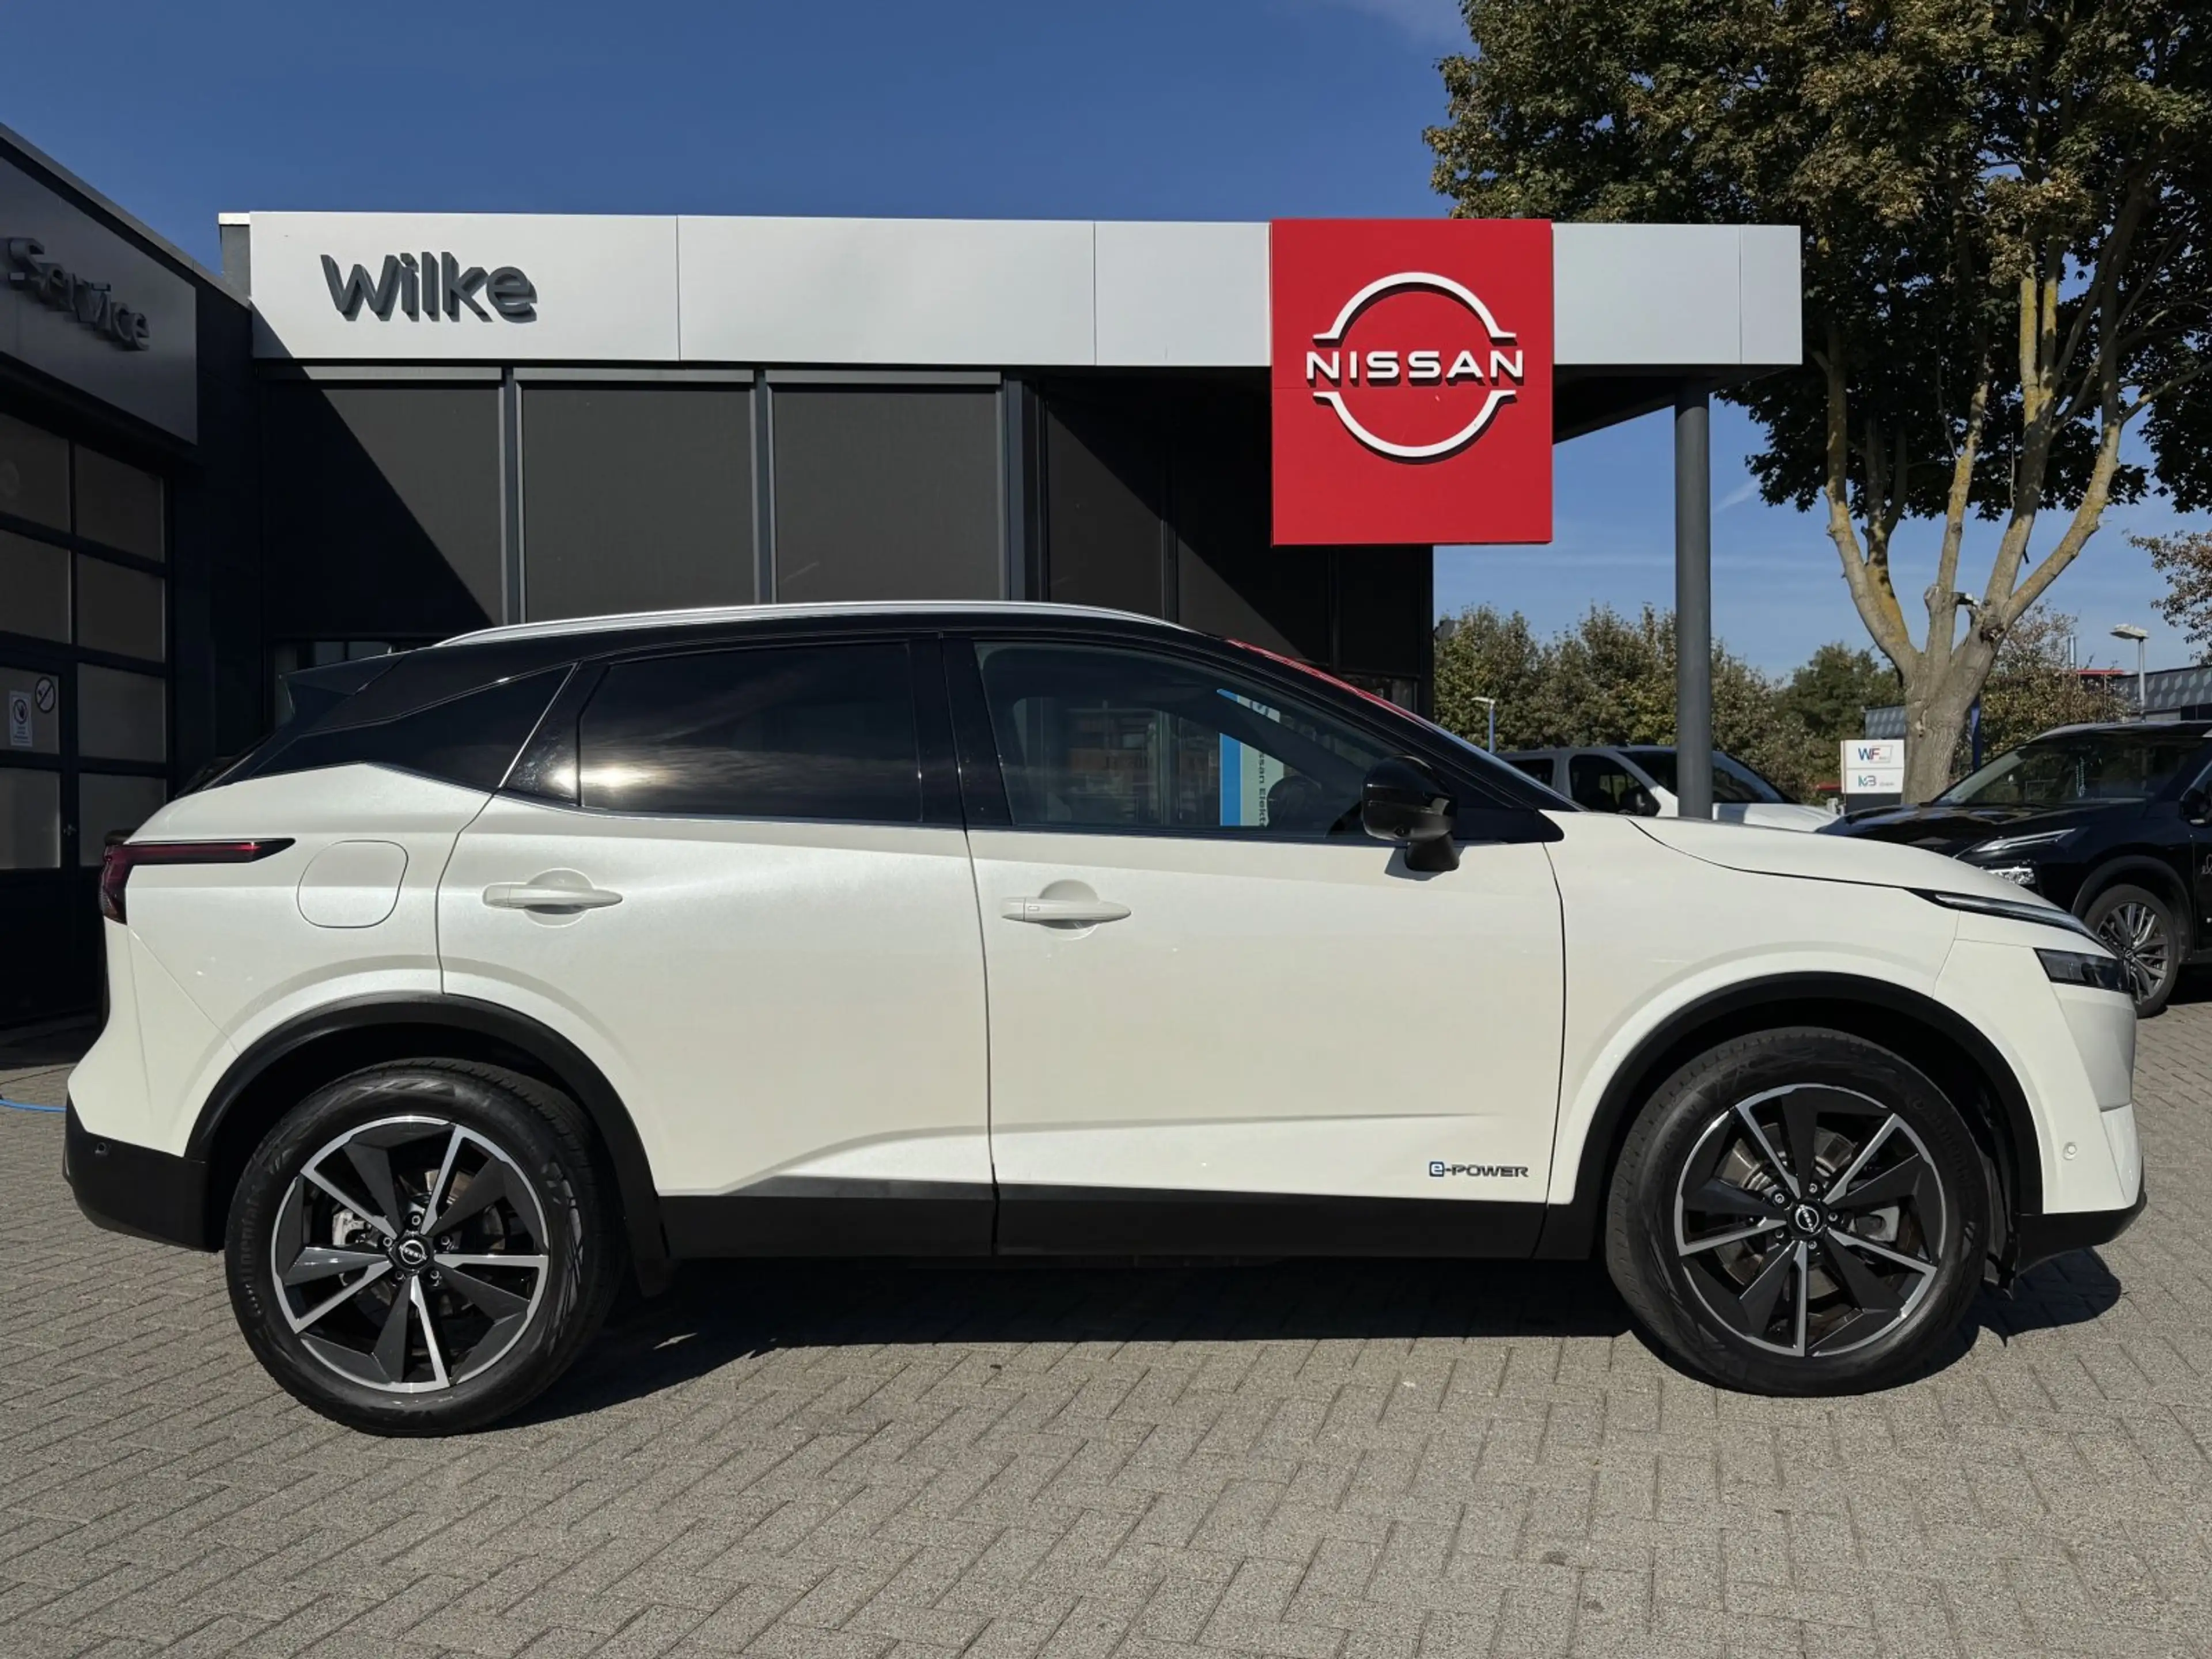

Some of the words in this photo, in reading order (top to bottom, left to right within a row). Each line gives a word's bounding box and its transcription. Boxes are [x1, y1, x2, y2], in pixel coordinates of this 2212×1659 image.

[9, 237, 150, 351] Service
[320, 252, 537, 324] Wilke
[1306, 350, 1524, 380] NISSAN
[1858, 748, 1881, 761] WF
[1429, 1161, 1529, 1177] e-POWER
